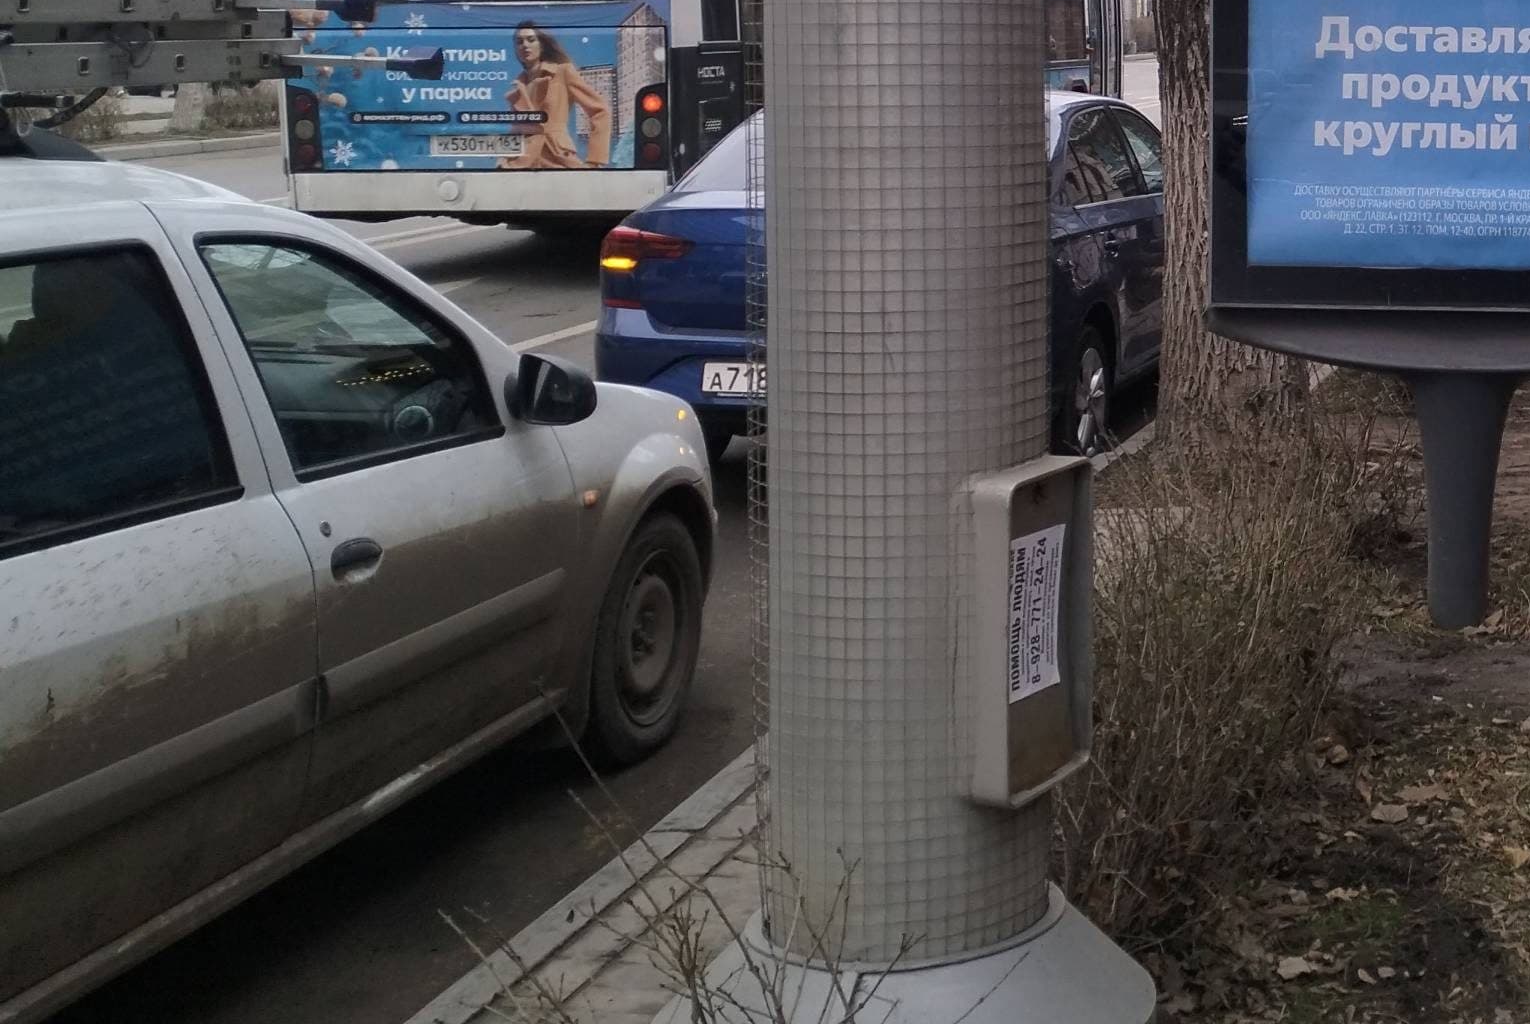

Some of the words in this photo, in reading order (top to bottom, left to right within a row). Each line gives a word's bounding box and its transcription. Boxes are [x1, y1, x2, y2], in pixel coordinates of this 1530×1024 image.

[386, 46, 507, 65] Ктиры
[386, 70, 508, 82] би-класса
[402, 87, 417, 104] у
[421, 87, 493, 103] парка
[1314, 113, 1518, 157] круглый
[1294, 185, 1342, 196] ДОСТАВКУ
[1315, 197, 1357, 208] ТОВАРОВ
[1419, 199, 1455, 210] ОБРАЗЫ
[1456, 200, 1497, 211] ТОВАРОВ
[1300, 210, 1321, 221] ООО
[1477, 226, 1502, 237] ОГРН
[1012, 546, 1027, 611] ЛЮДЯМ
[1031, 536, 1048, 684] 8-928-771-24-24
[1011, 616, 1022, 692] ПОМОЩЬ
